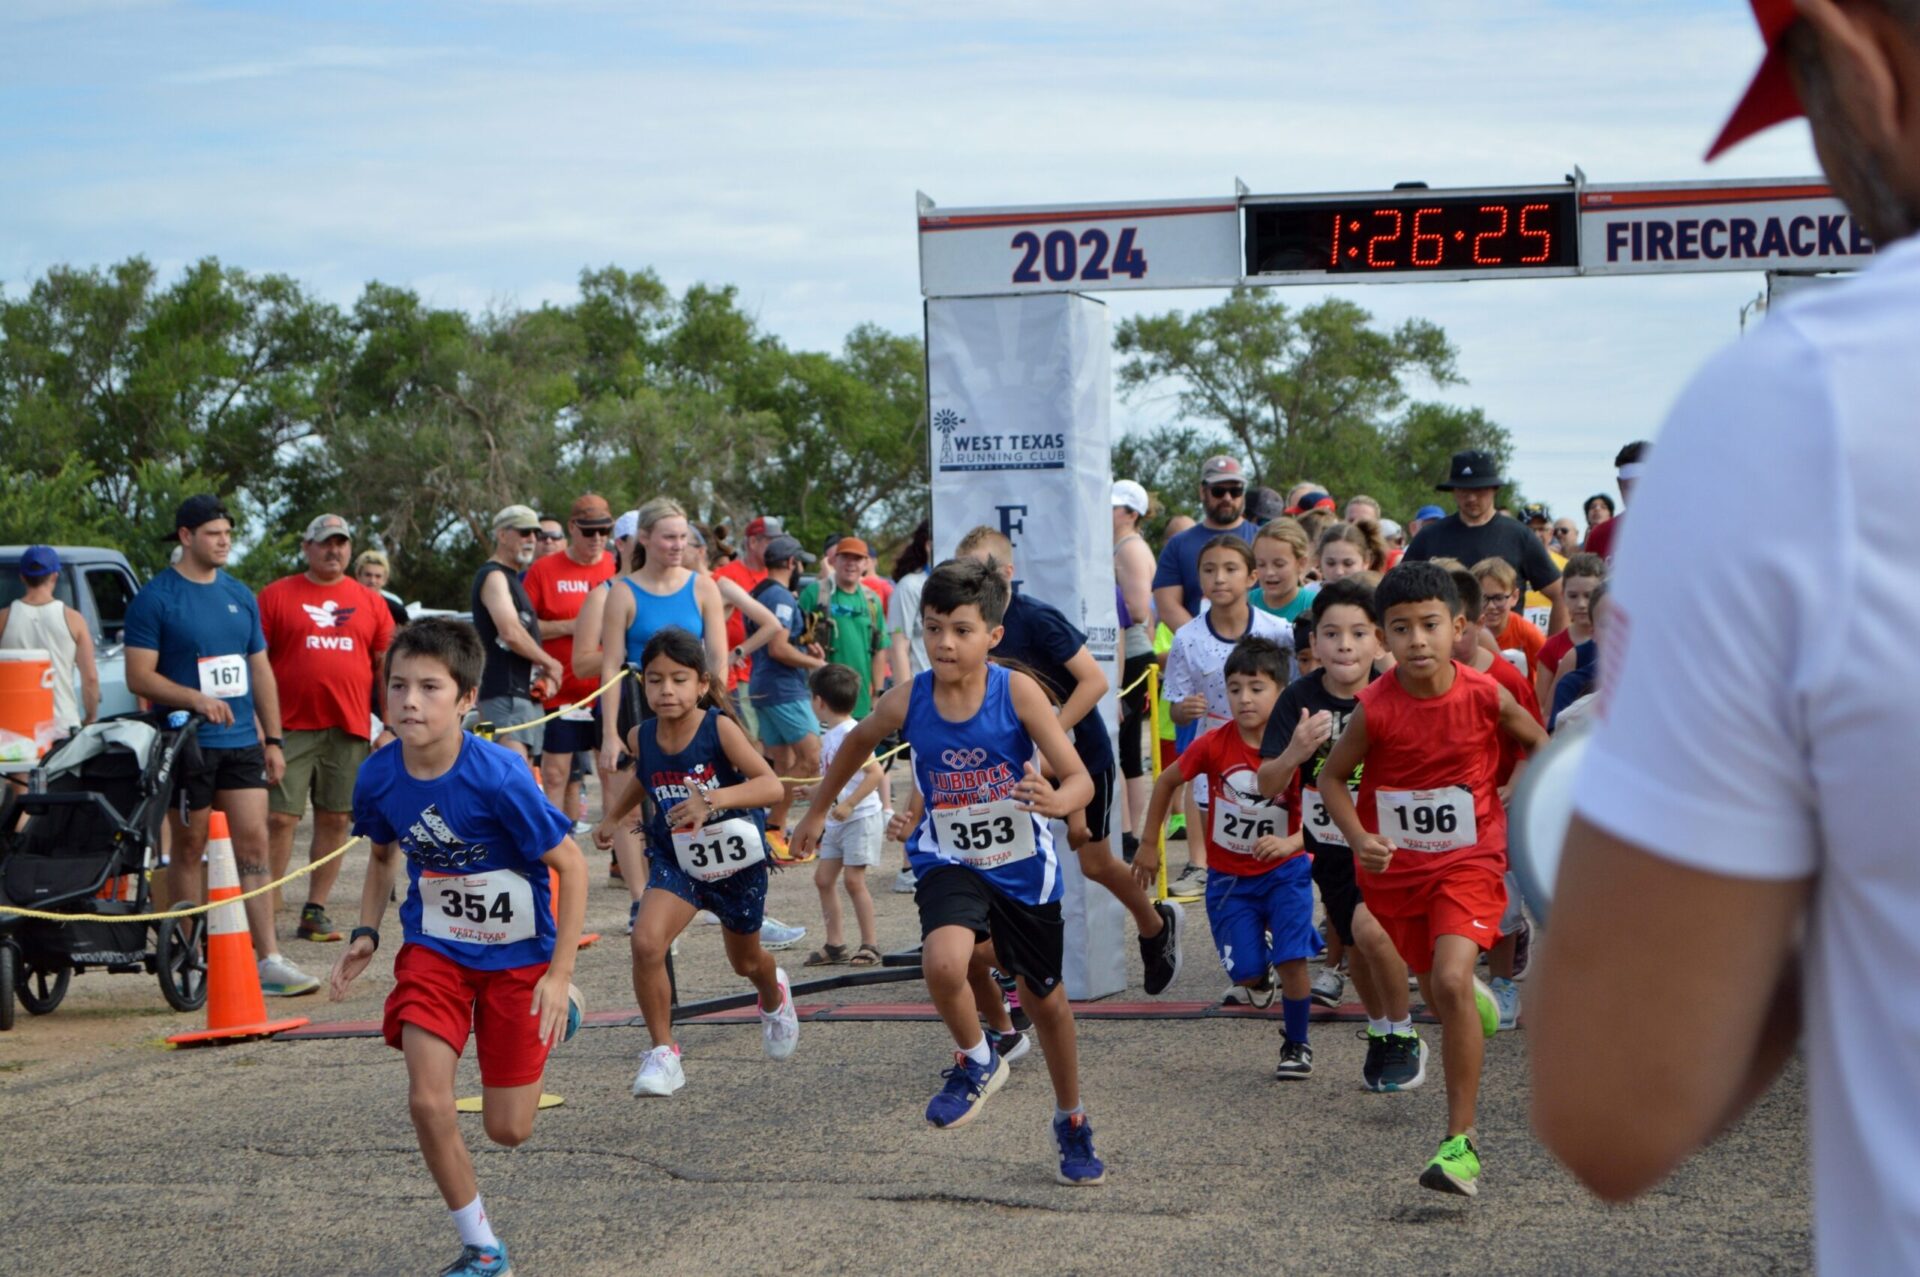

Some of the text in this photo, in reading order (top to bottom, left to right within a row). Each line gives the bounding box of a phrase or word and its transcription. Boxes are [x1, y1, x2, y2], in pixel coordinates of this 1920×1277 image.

[1010, 227, 1148, 284] 2024
[954, 433, 1065, 452] WEST TEXAS
[957, 450, 1066, 463] RUNNING CLUB
[556, 580, 589, 593] RUN
[306, 635, 353, 651] RWB
[210, 666, 241, 686] 167
[929, 761, 1012, 791] LUBBOCK
[1223, 813, 1274, 839] 276
[1393, 804, 1457, 834] 196
[950, 816, 1015, 850] 353
[689, 835, 747, 868] 313
[440, 889, 513, 924] 354
[449, 926, 474, 938] WEST
[477, 930, 507, 940] TEXAS
